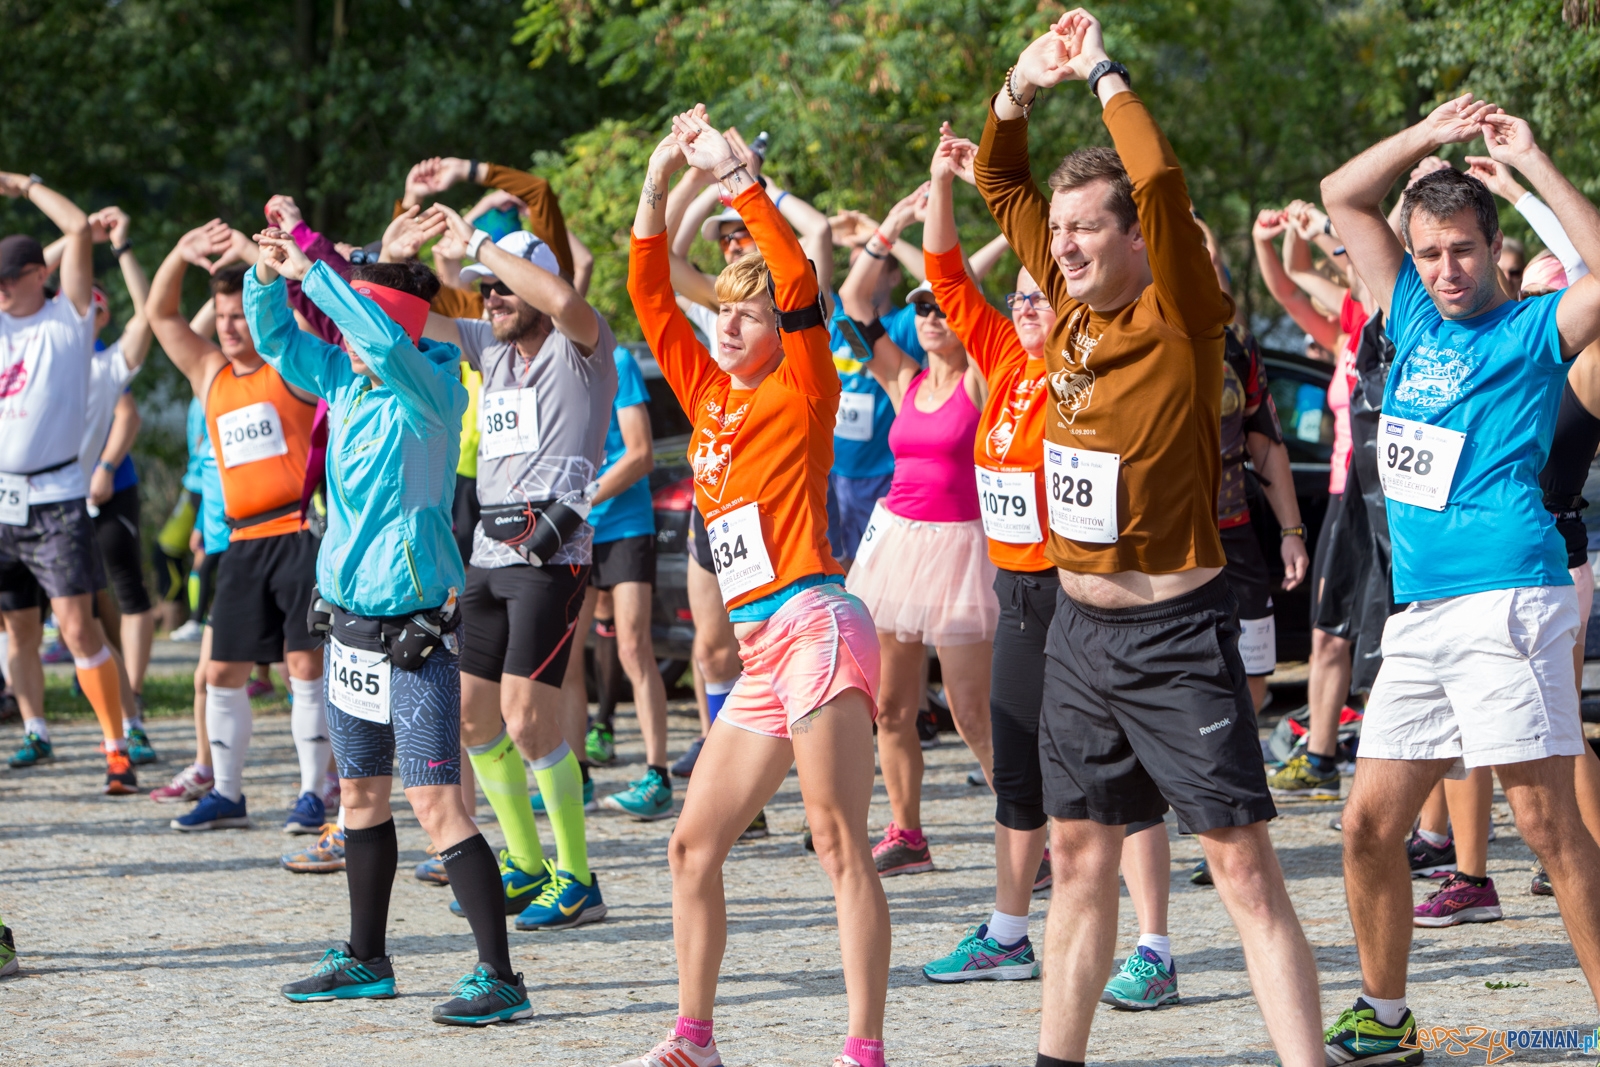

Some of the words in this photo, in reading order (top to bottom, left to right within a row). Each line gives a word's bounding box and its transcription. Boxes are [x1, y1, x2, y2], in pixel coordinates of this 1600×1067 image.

[224, 419, 273, 446] 2068
[486, 410, 519, 434] 389
[1387, 442, 1434, 476] 928
[1053, 472, 1093, 507] 828
[983, 490, 1027, 517] 1079
[1069, 514, 1105, 527] LECHITÓW
[713, 533, 748, 574] 834
[733, 562, 762, 581] LECHITÓW
[333, 660, 380, 696] 1465
[1199, 717, 1232, 736] Reebok
